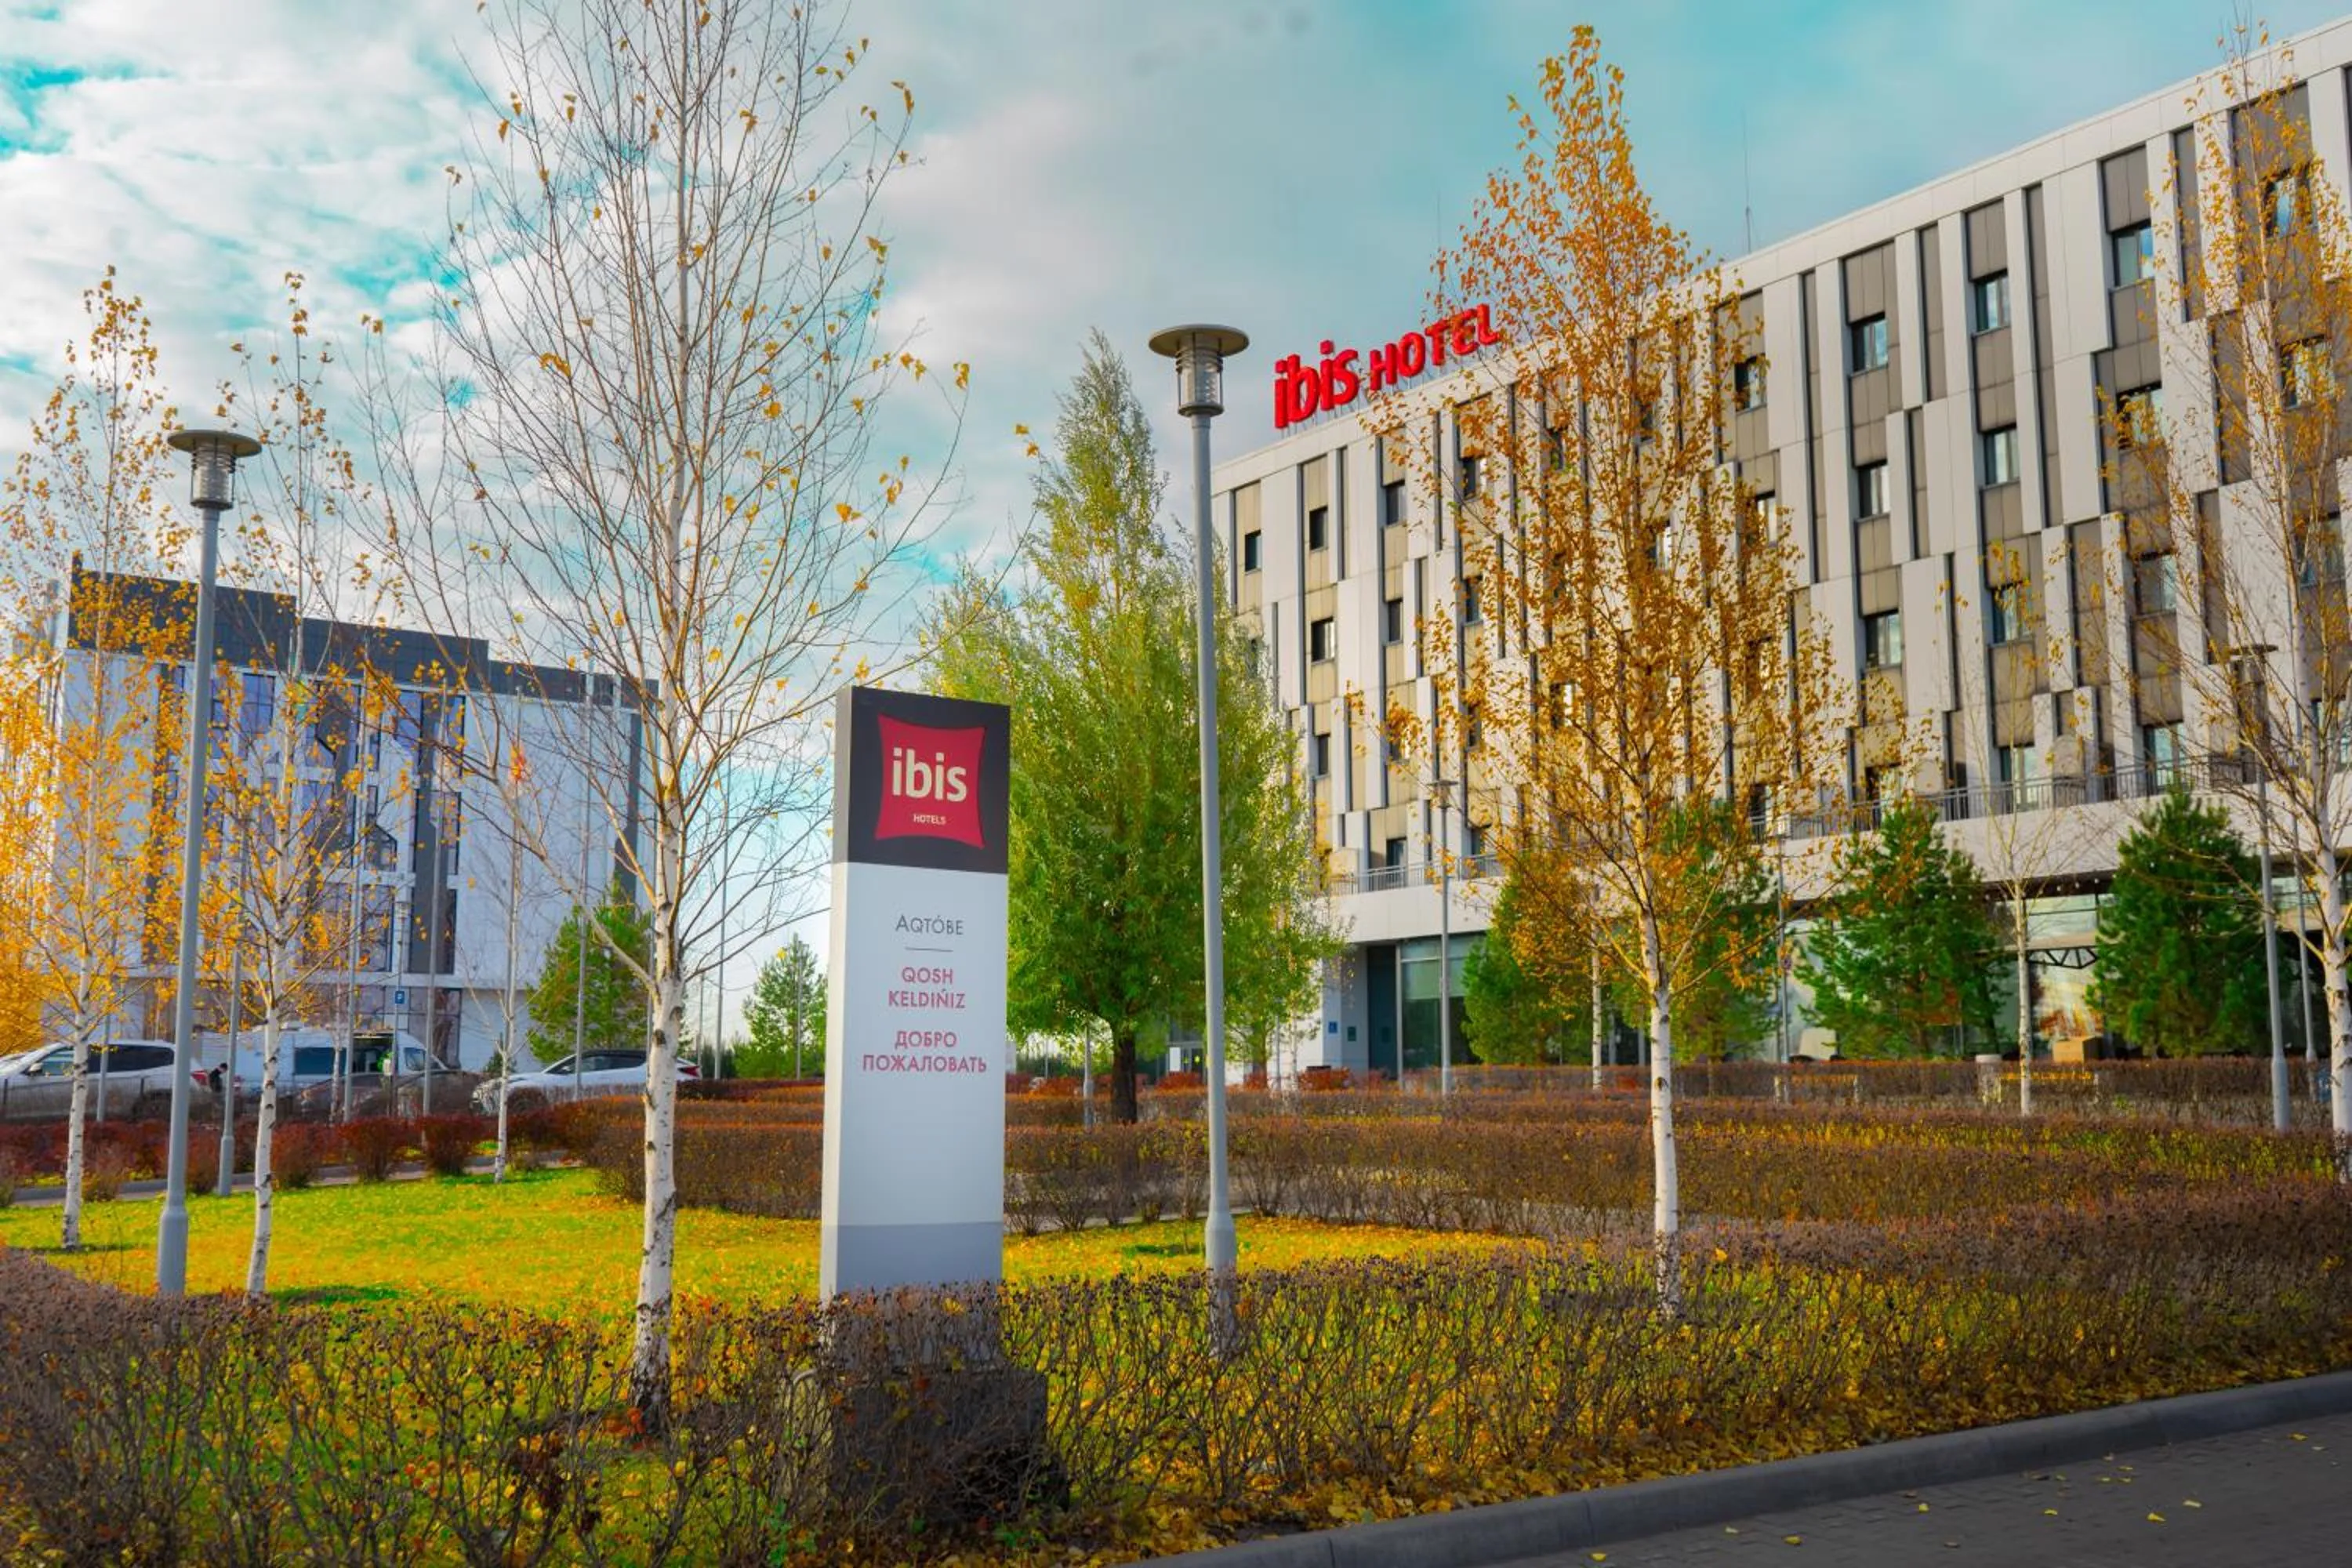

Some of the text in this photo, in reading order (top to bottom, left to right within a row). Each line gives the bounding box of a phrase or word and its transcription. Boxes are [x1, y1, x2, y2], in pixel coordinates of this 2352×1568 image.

[1275, 303, 1501, 430] ibis HOTEL
[892, 747, 967, 802] ibis
[913, 813, 947, 826] HOTELS
[902, 967, 953, 984] QOSH
[895, 1031, 957, 1050] ДОБРО
[862, 1054, 987, 1073] ПОЖАЛОВАТЬ
